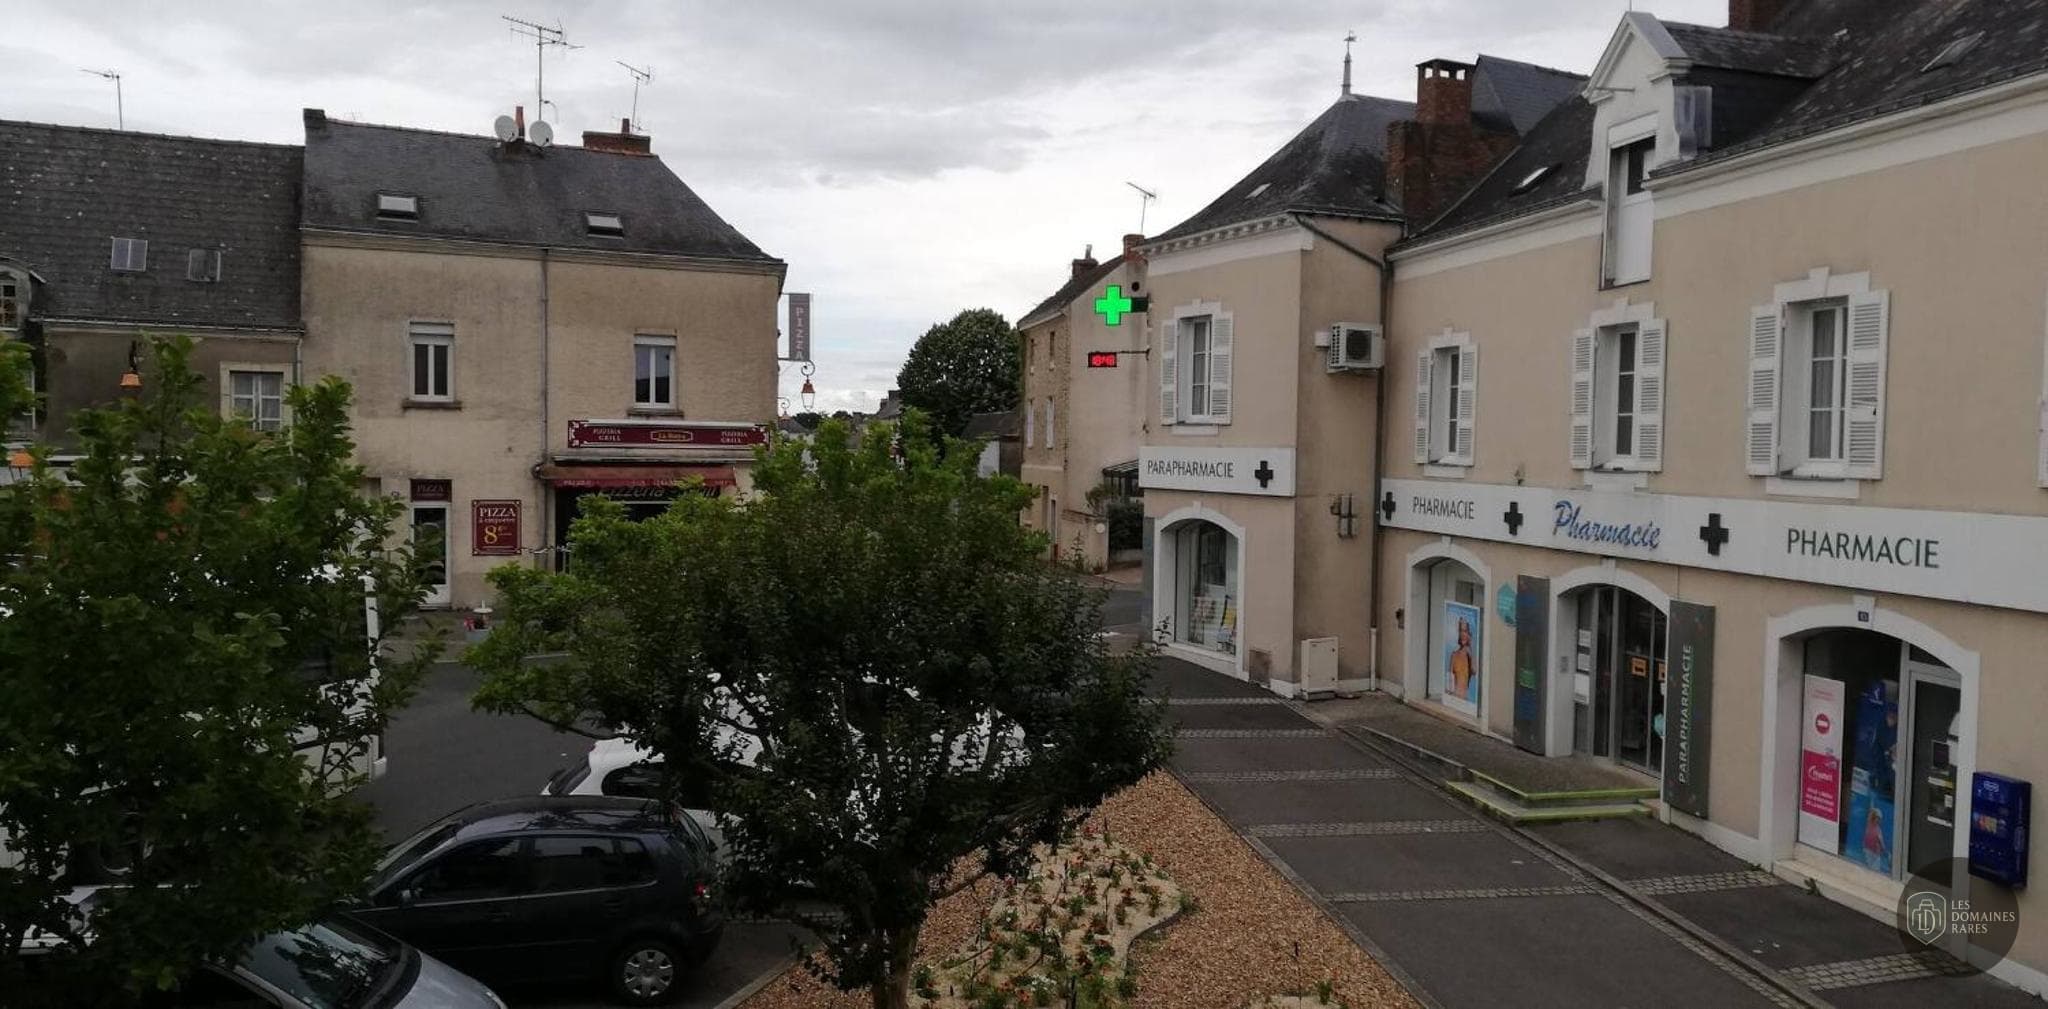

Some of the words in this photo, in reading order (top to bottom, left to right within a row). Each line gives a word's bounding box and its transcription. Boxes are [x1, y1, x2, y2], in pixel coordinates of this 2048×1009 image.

[795, 306, 804, 359] PIZZA
[1147, 460, 1234, 478] PARAPHARMACIE
[479, 508, 516, 517] PIZZA
[1412, 497, 1475, 520] PHARMACIE
[1554, 500, 1660, 549] Pharmacie
[1787, 528, 1940, 569] PHARMACIE
[1678, 645, 1694, 784] PARAPHARMACIE
